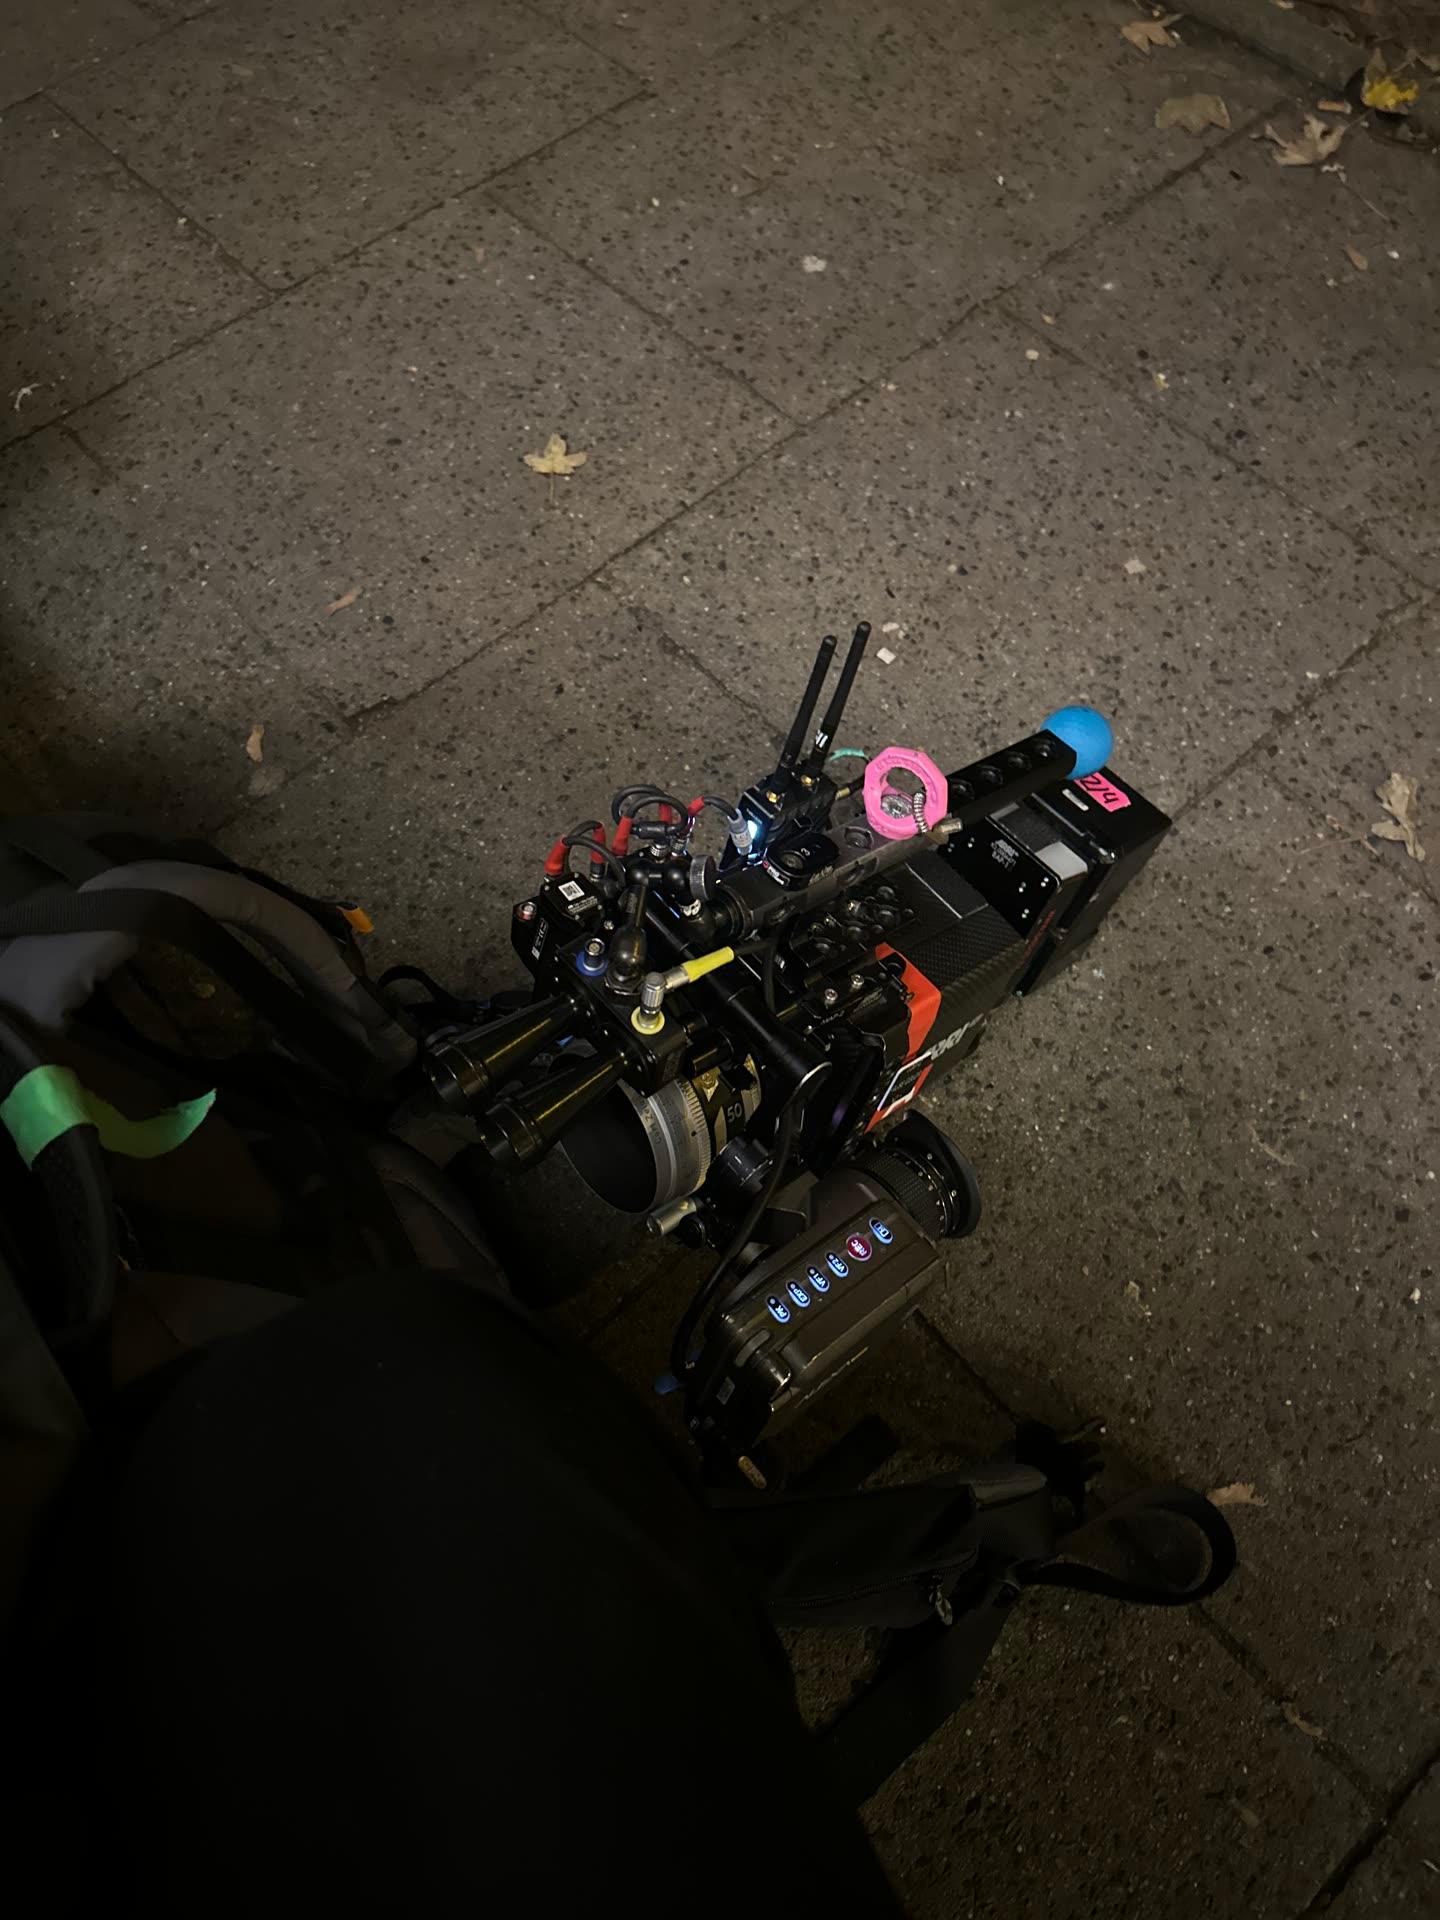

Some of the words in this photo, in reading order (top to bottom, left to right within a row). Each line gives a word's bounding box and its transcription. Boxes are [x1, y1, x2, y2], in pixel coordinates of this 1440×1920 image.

[726, 1102, 743, 1124] 50
[850, 1238, 868, 1258] REC
[831, 1257, 845, 1272] VF2
[813, 1272, 826, 1288] VF1
[793, 1287, 808, 1303] EXP
[775, 1304, 787, 1319] PK
